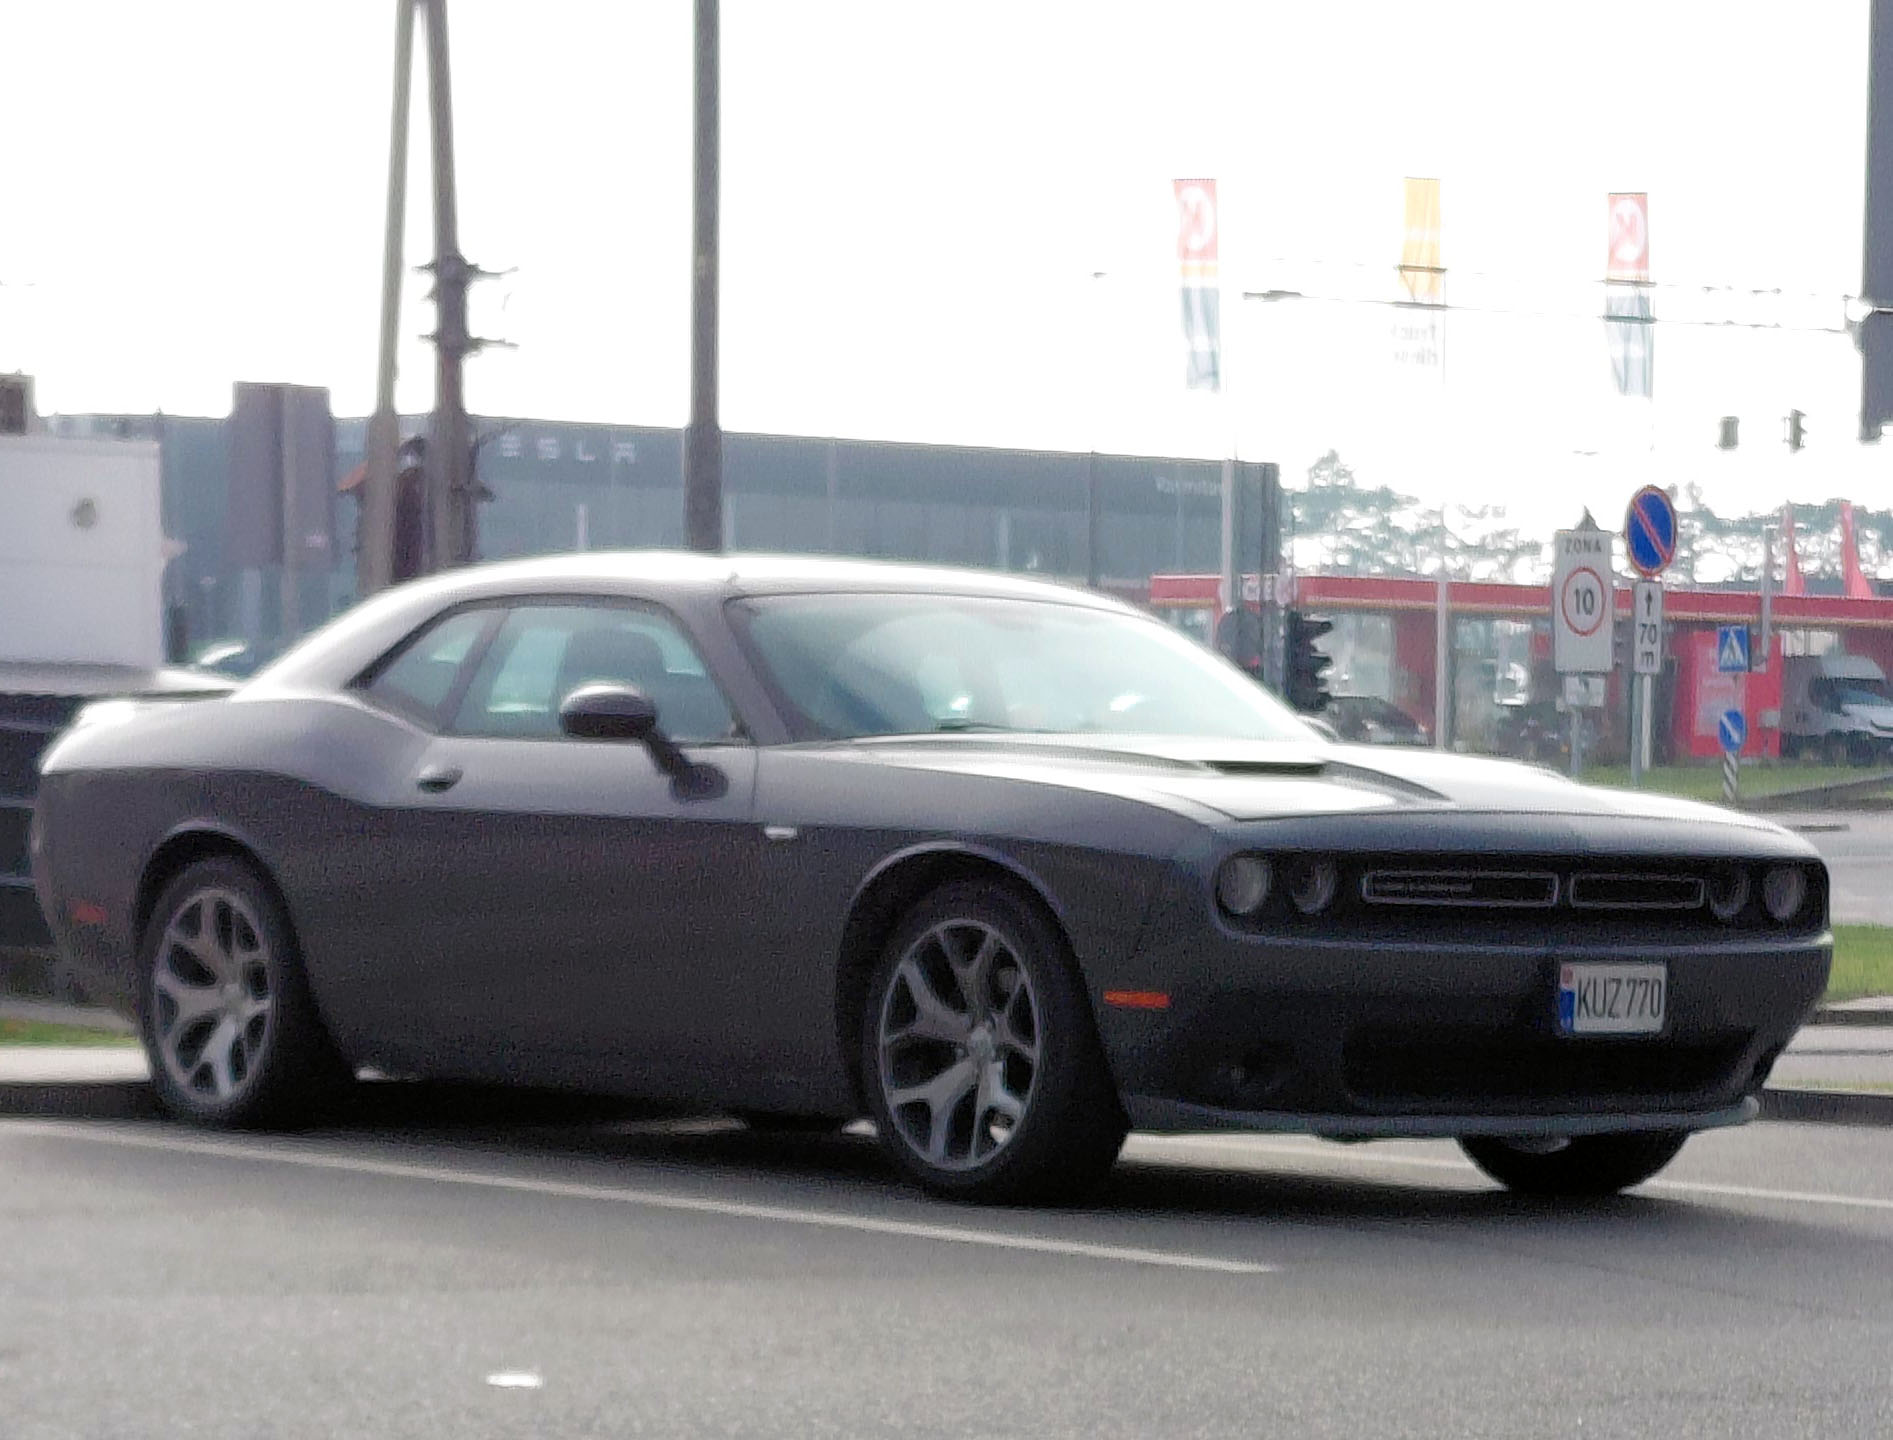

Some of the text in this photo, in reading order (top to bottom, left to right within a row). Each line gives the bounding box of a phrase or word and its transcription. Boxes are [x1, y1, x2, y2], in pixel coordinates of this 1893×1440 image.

[501, 433, 636, 464] ESLA
[1565, 538, 1601, 553] ZONA
[1574, 588, 1595, 616] 10
[1640, 623, 1657, 645] 70
